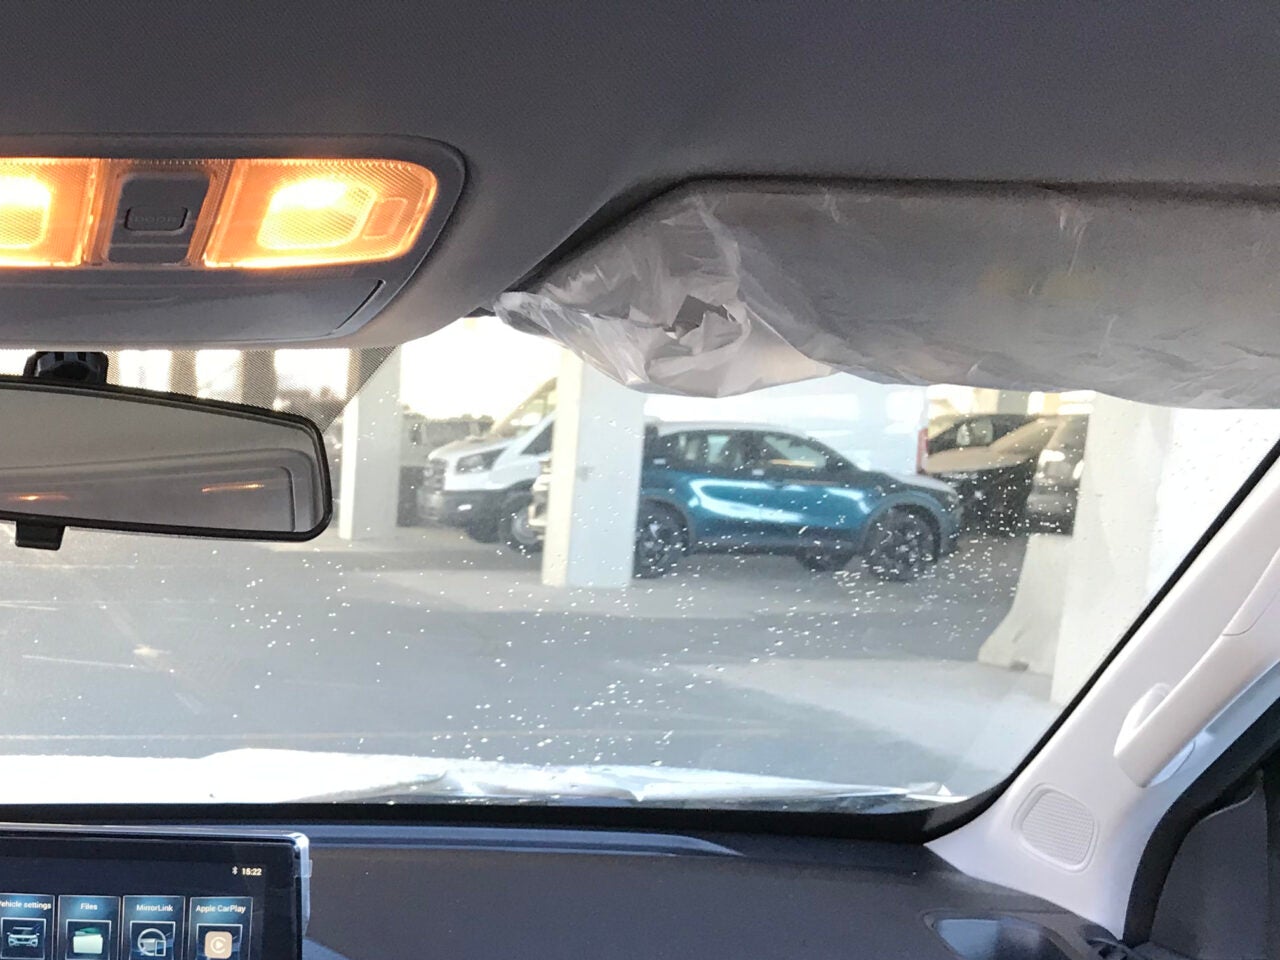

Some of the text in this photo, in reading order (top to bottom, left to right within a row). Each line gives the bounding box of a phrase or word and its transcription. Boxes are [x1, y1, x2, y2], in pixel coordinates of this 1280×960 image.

[23, 901, 52, 910] settings
[80, 902, 98, 911] Files
[136, 904, 174, 913] MirrorLink
[195, 904, 246, 913] Apple CarPlay
